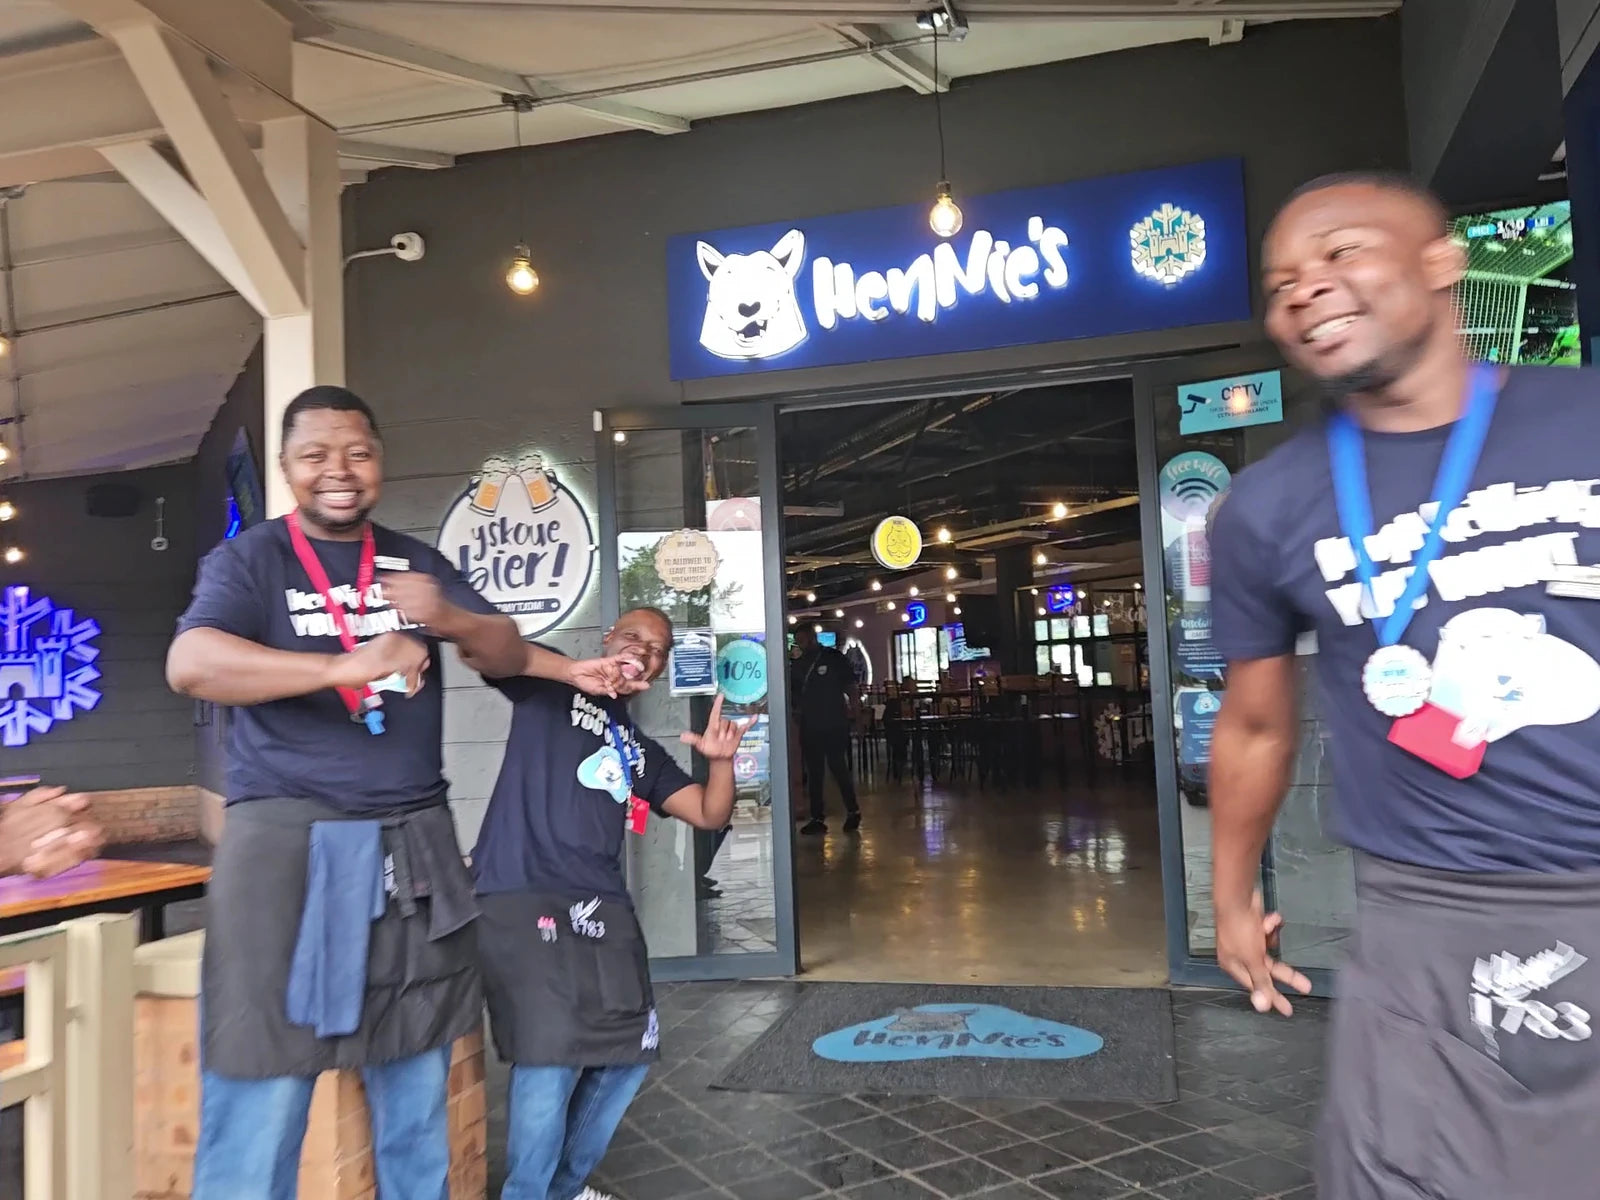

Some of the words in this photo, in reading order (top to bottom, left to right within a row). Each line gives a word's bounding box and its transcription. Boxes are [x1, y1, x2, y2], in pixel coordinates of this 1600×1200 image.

[1221, 382, 1263, 401] CCTV
[472, 516, 561, 561] yskoue
[669, 567, 686, 575] LEAVE
[688, 566, 707, 574] THESE
[672, 557, 702, 565] ALLOWED
[704, 556, 712, 564] TO
[723, 659, 762, 681] 10%
[570, 709, 604, 736] YOU
